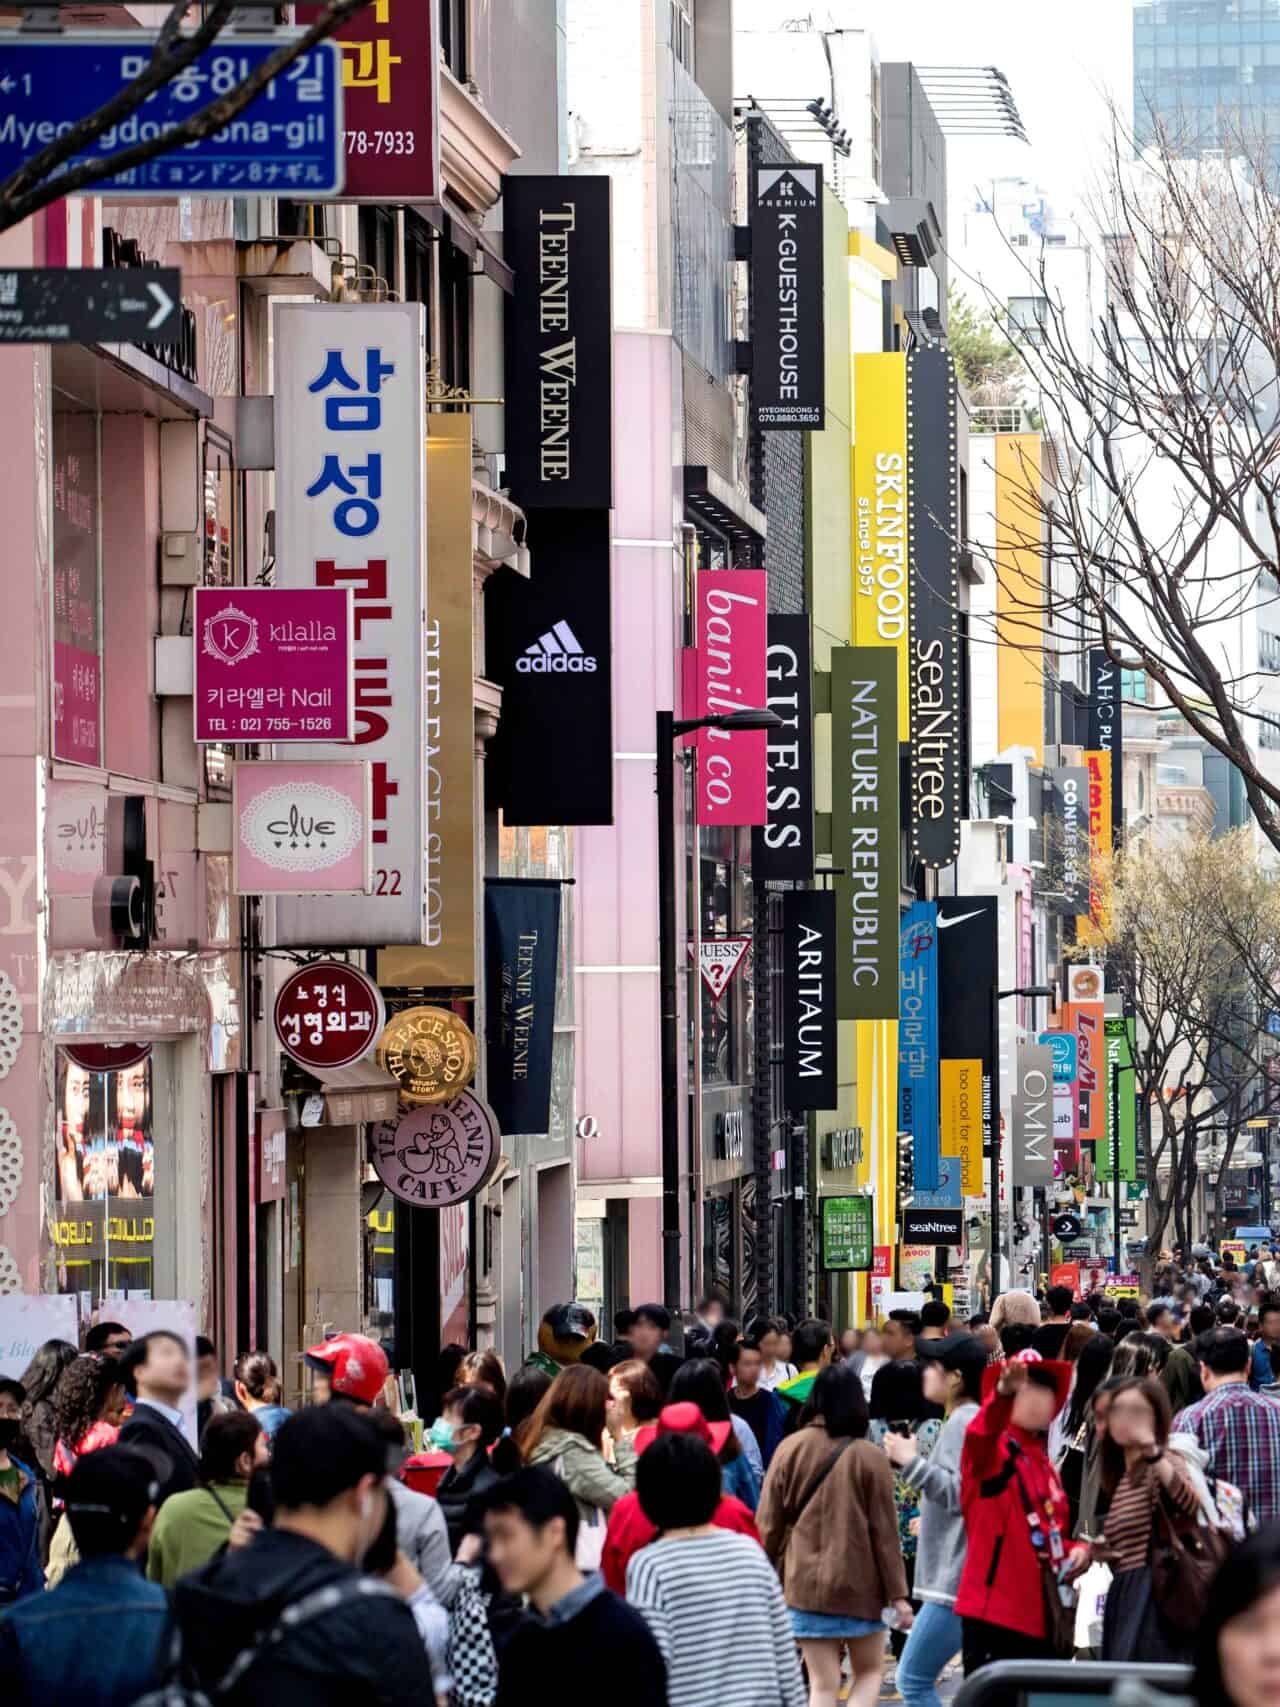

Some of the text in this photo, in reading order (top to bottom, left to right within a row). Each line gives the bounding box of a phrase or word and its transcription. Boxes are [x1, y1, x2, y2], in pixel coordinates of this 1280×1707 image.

[758, 199, 816, 208] PREMIUM
[778, 212, 799, 400] K-GUESTHOUSE
[306, 347, 395, 538] 삼성
[875, 452, 905, 640] SKINFOOD
[208, 686, 332, 710] 키라엘라 Nail
[515, 654, 598, 673] adidas
[917, 639, 953, 819] seaNtree
[763, 644, 801, 849] GUESS
[851, 680, 880, 987] NATURE REPUBLIC
[281, 1011, 372, 1047] 성형외과
[798, 923, 823, 1078] ARITAUM
[443, 1098, 484, 1169] EENIE
[909, 1221, 958, 1233] seaNtree
